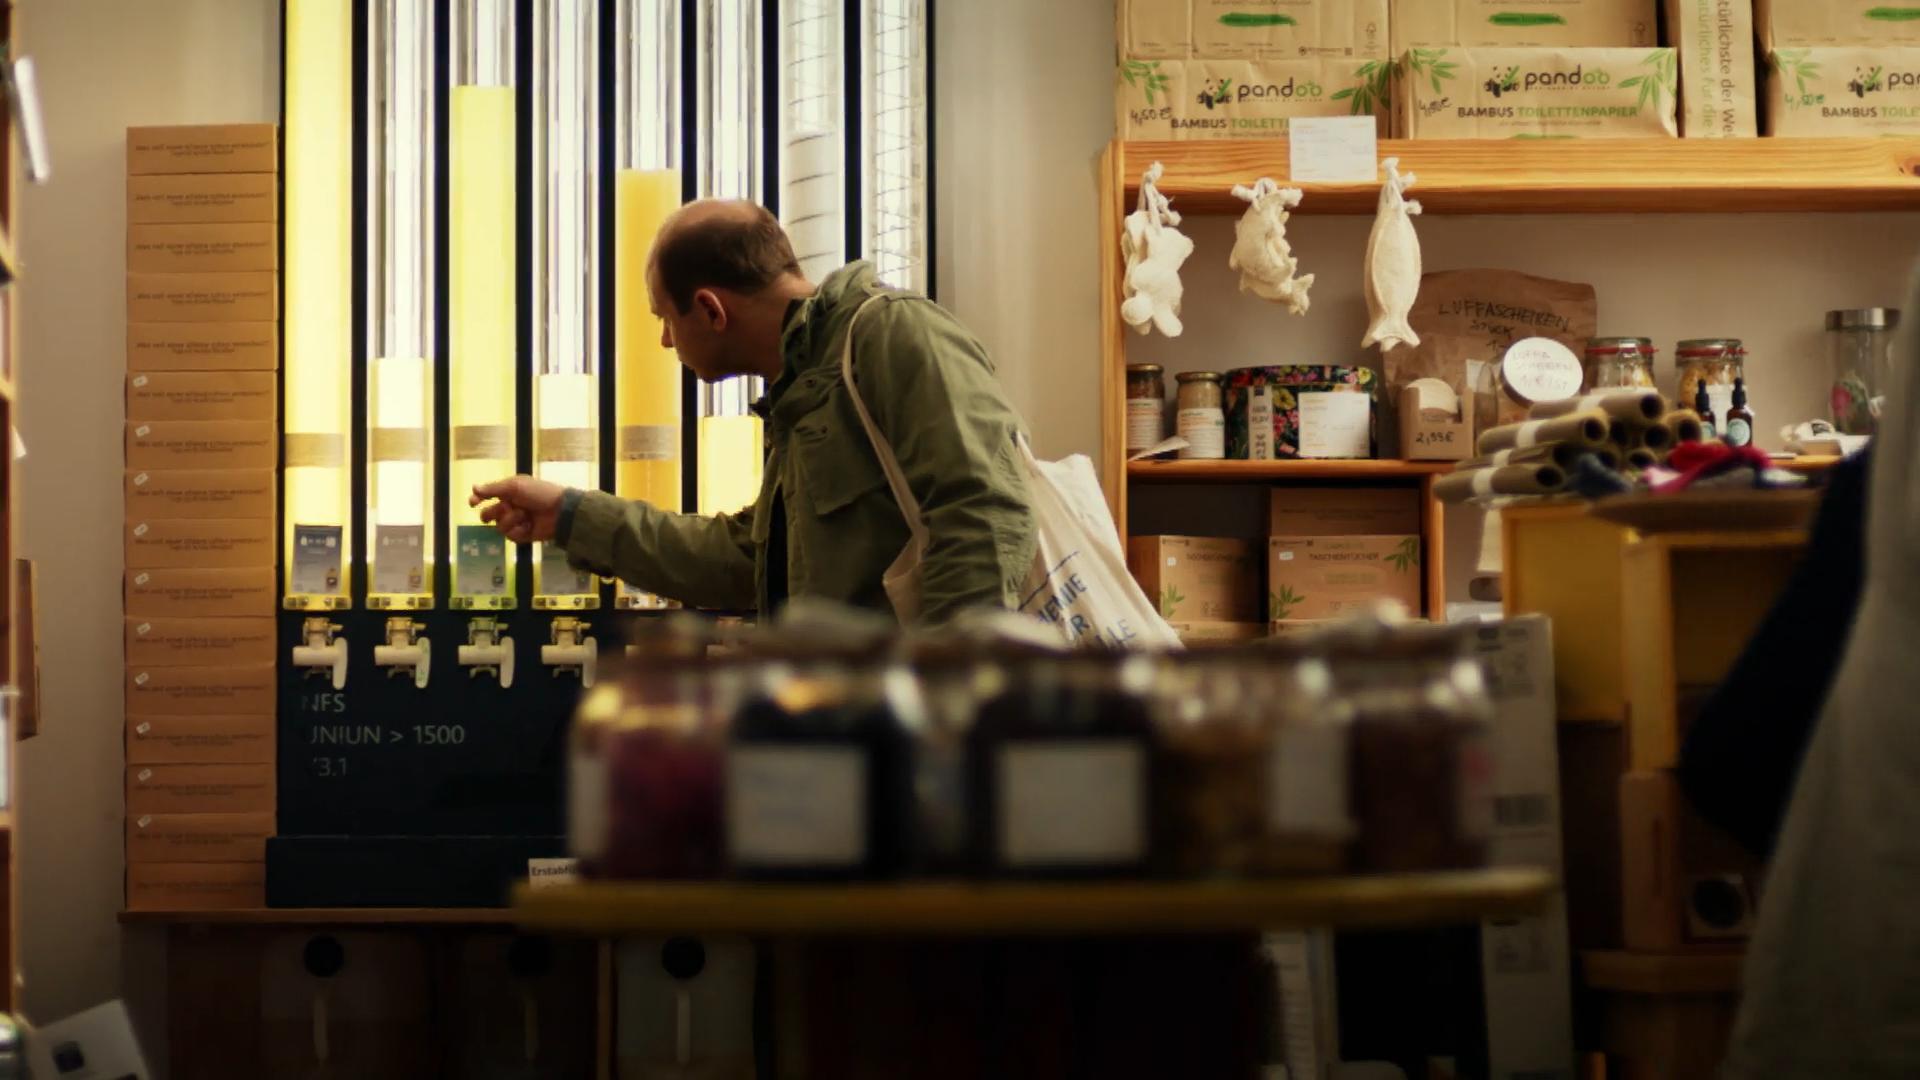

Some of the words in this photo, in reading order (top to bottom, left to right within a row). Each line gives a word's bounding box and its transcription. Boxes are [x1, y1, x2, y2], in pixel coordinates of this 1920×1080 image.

[1720, 79, 1736, 105] der
[1457, 106, 1514, 118] BAMBUS
[1518, 106, 1638, 118] TOILETTENPAPIER
[1821, 106, 1878, 118] BAMBUS
[1171, 118, 1227, 129] BAMBUS
[413, 724, 467, 745] 1500
[312, 756, 347, 777] 3.1
